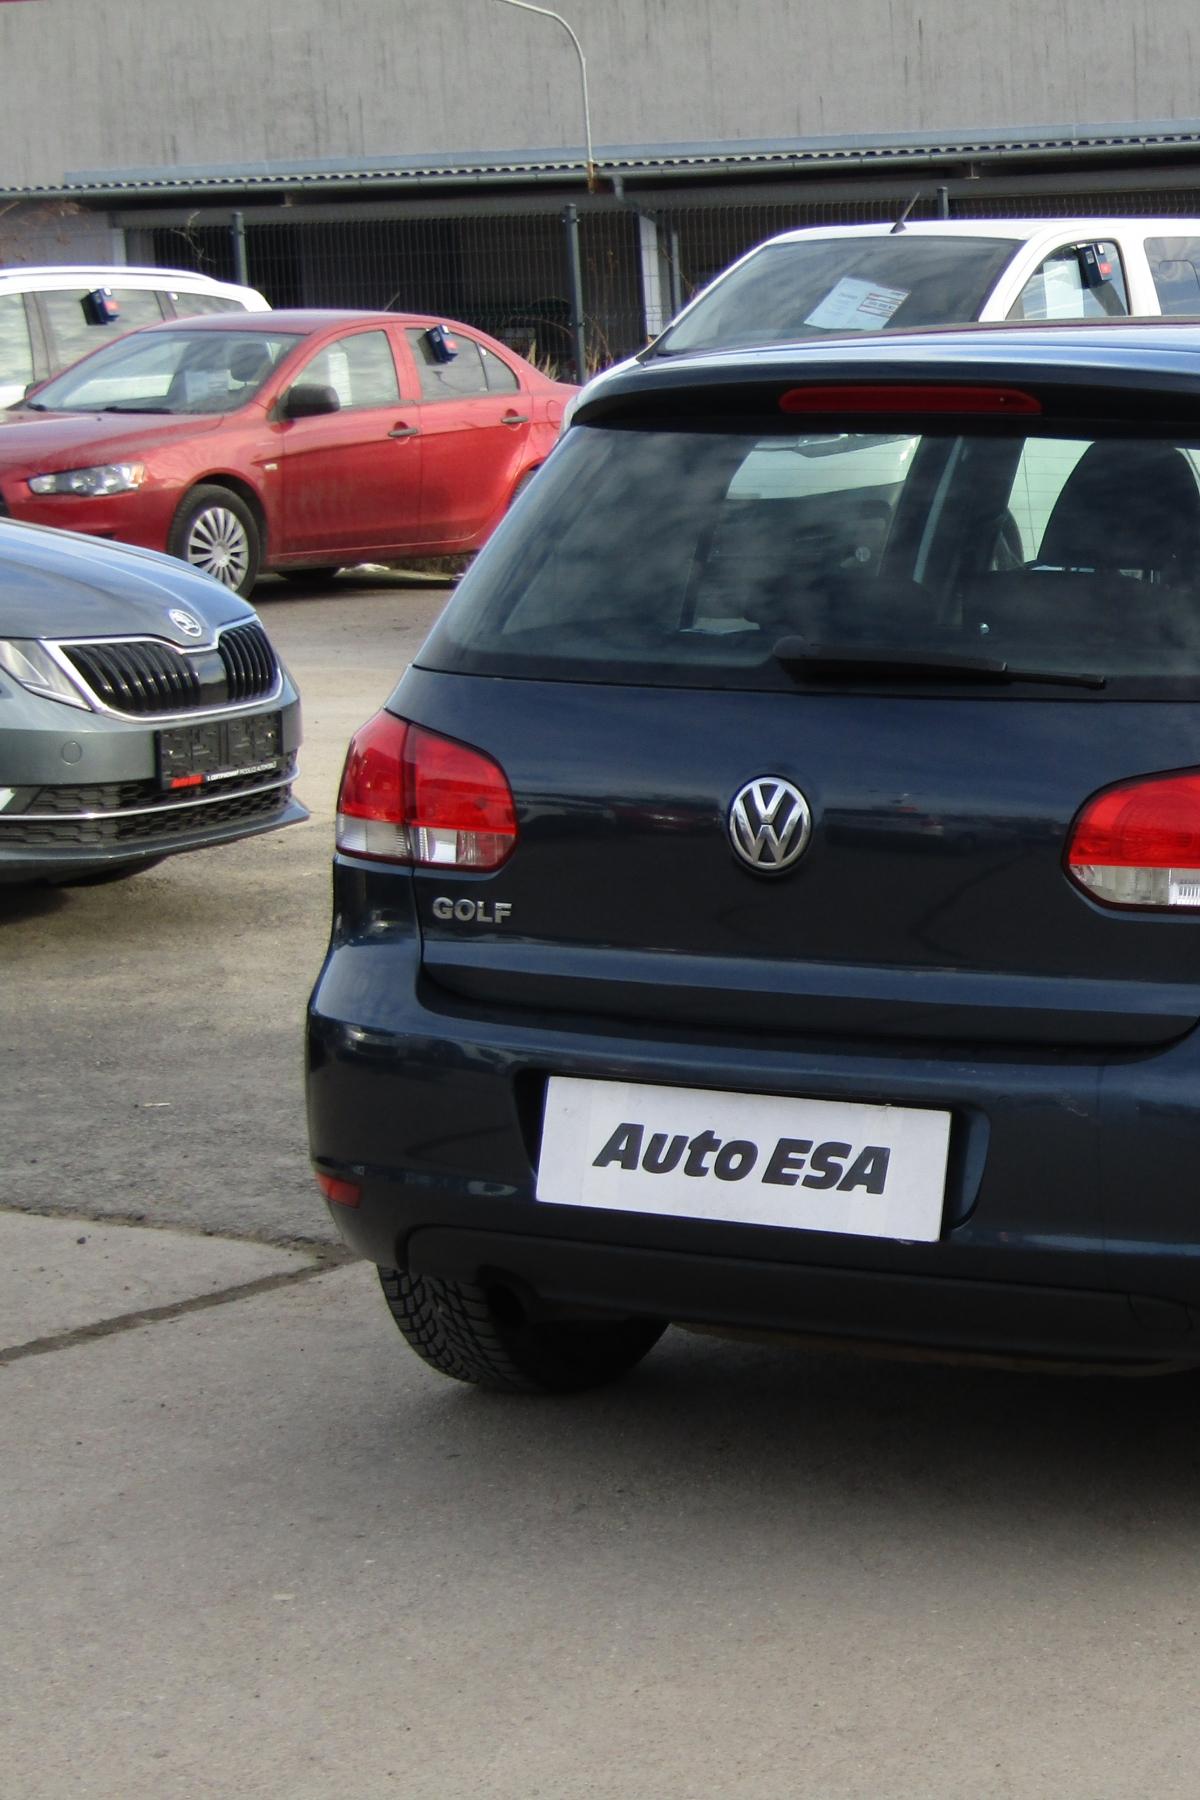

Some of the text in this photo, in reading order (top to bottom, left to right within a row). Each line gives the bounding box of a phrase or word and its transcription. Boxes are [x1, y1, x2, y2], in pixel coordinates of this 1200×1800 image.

[731, 777, 811, 869] VW
[432, 896, 513, 924] GOLF
[592, 1122, 891, 1195] Auto ESA
